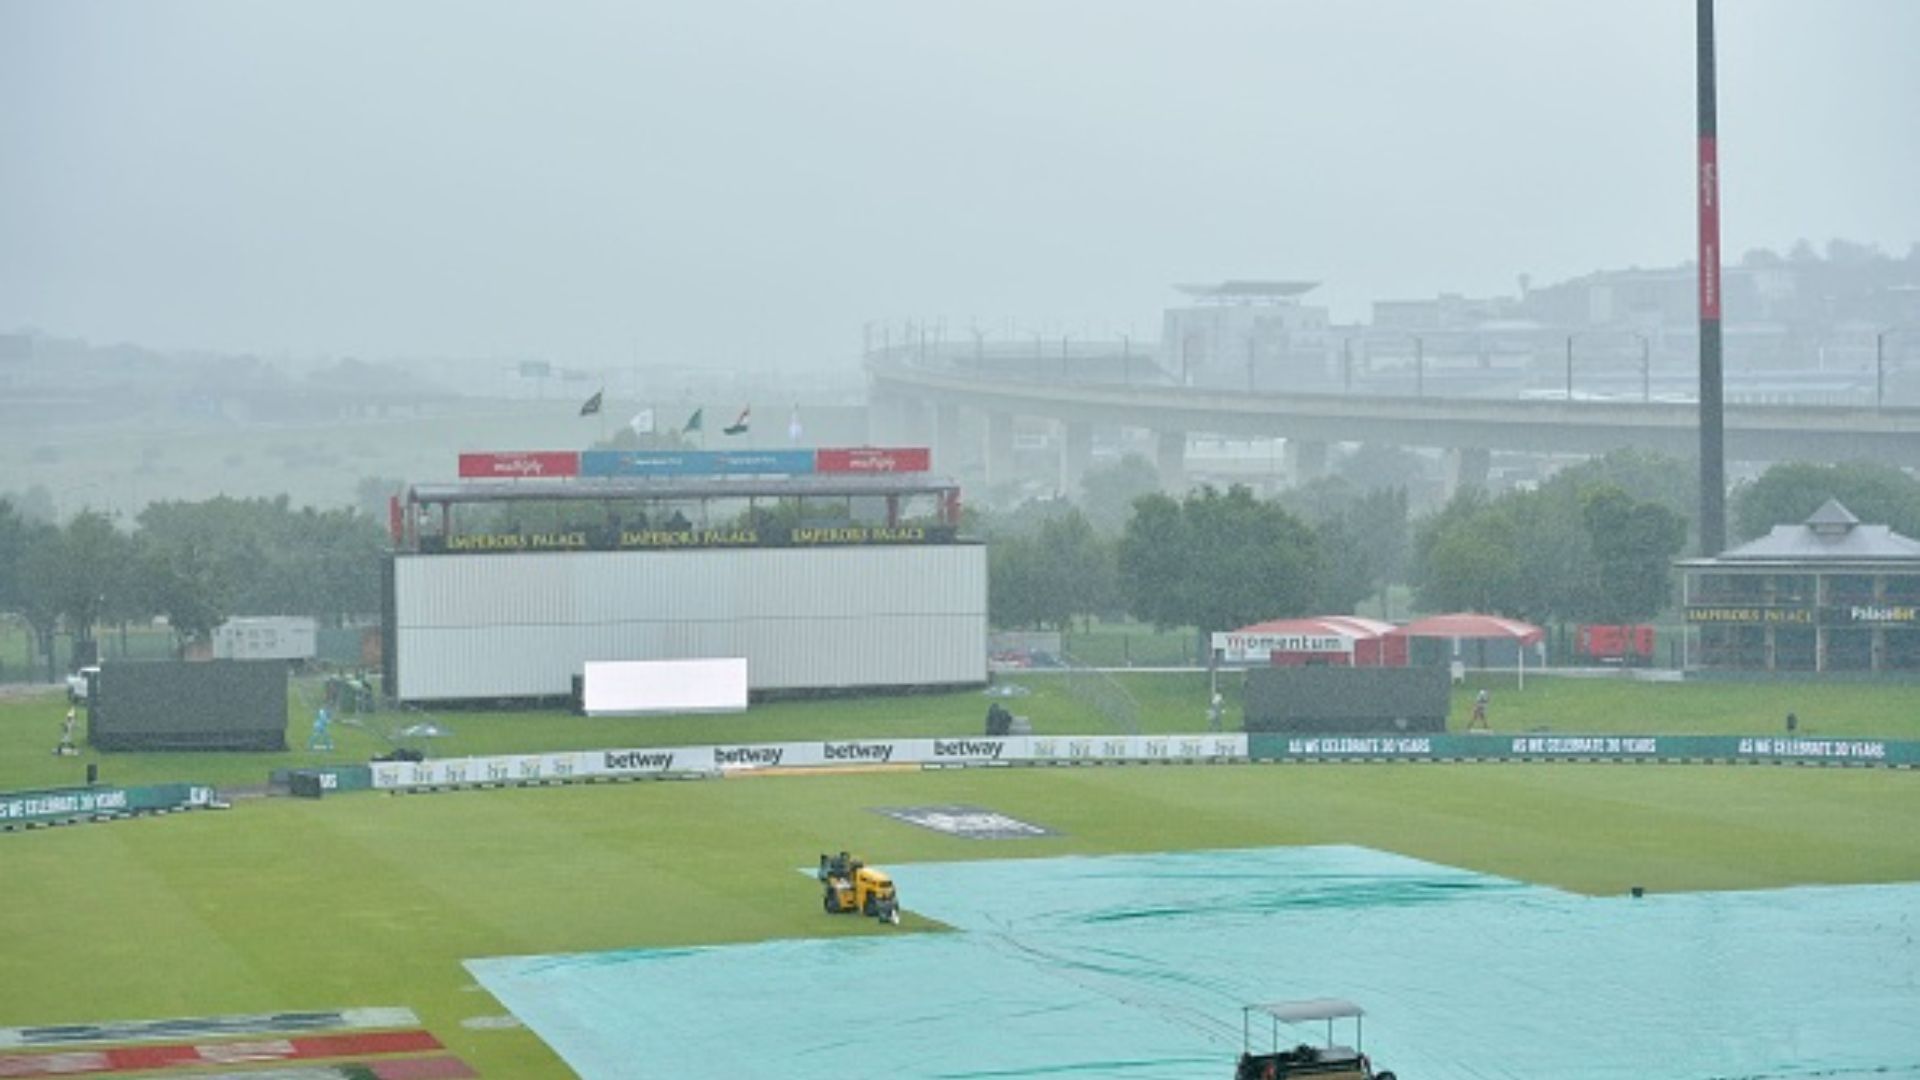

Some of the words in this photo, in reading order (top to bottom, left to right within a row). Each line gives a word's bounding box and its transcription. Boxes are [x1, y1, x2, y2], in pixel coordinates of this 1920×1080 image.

[1225, 635, 1340, 650] momentum
[824, 742, 893, 762] betway
[933, 740, 1004, 760] betway
[1321, 738, 1378, 753] CELEBRATE
[1774, 740, 1831, 756] CELEBRATE
[604, 751, 674, 771] betway
[714, 748, 783, 765] betway
